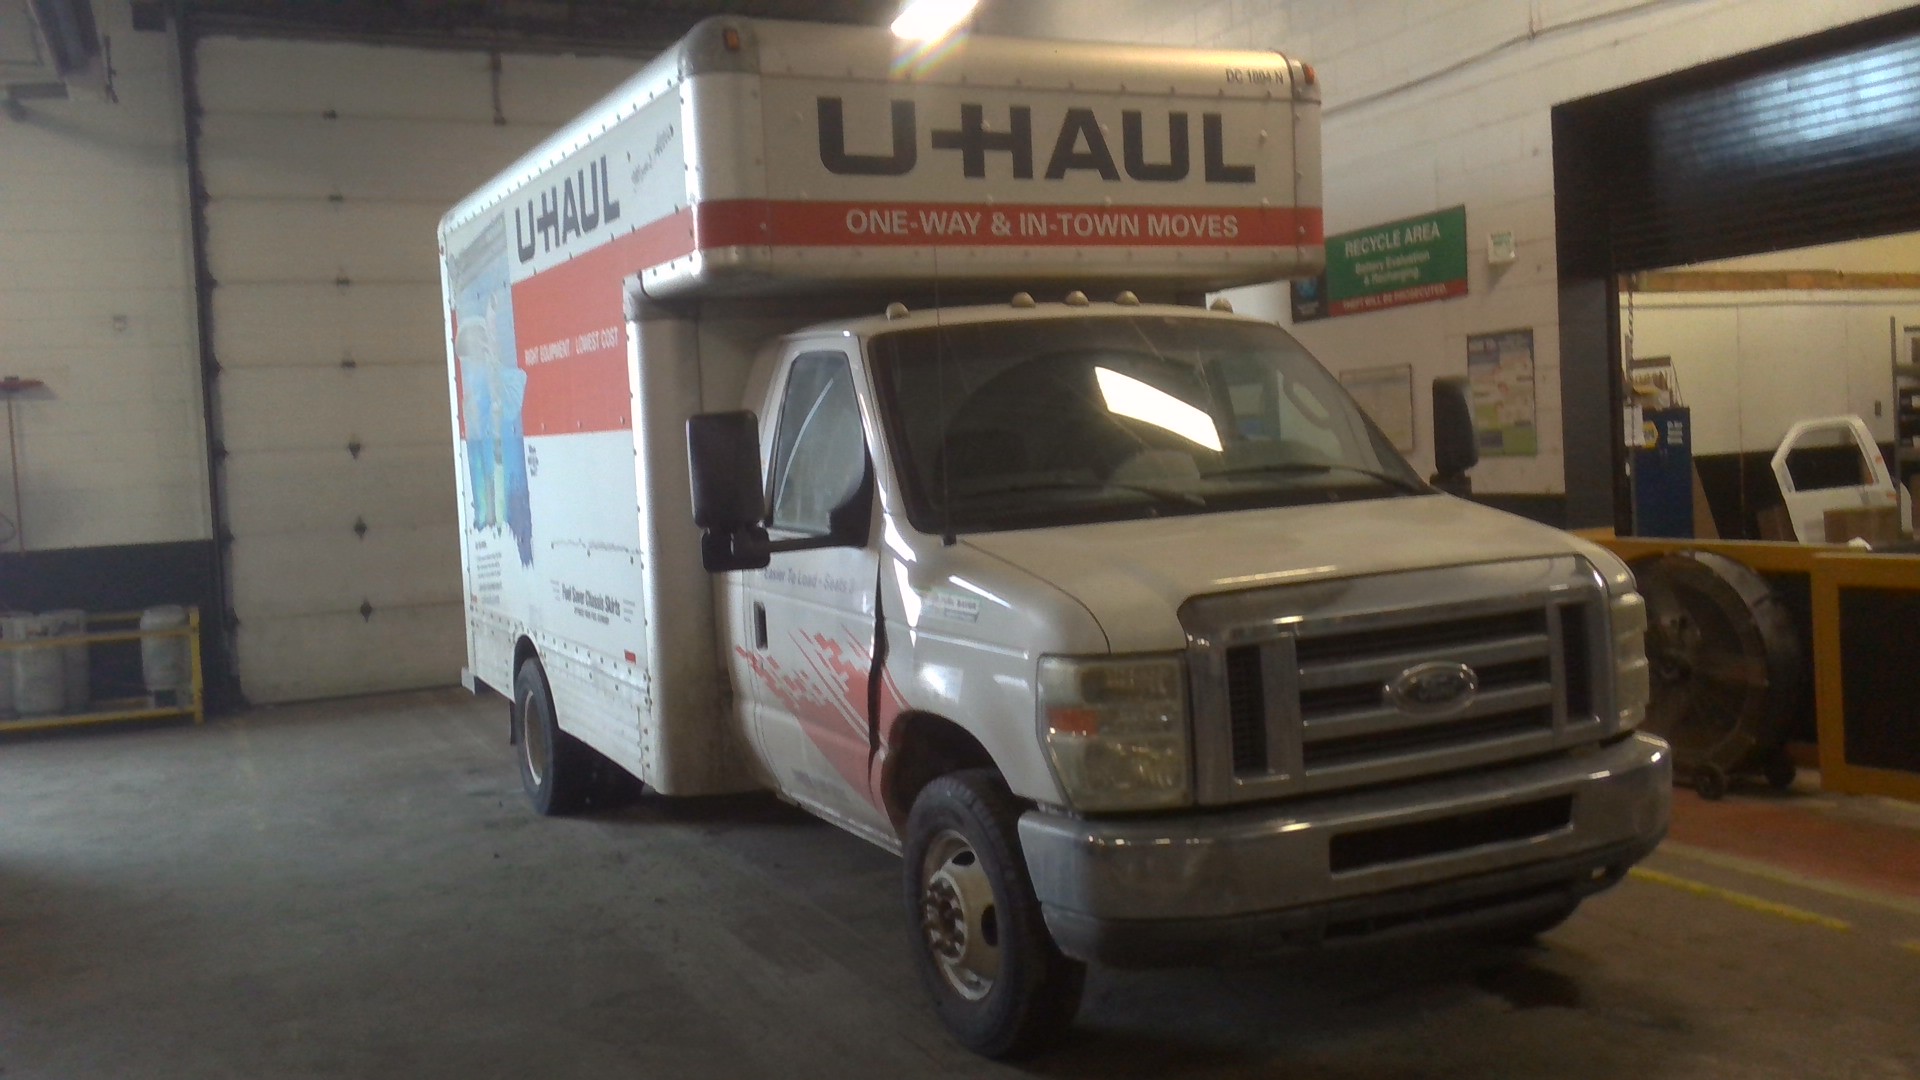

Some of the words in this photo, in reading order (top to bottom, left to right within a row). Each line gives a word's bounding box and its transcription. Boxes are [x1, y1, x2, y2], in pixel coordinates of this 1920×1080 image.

[1274, 69, 1284, 85] N
[845, 208, 982, 236] ONE-WAY
[990, 211, 1012, 237] &
[1019, 212, 1139, 238] IN-TOWN
[1147, 214, 1240, 239] MOVES
[1345, 229, 1401, 258] RECYCLE
[1404, 221, 1441, 246] AREA
[601, 326, 619, 350] COST
